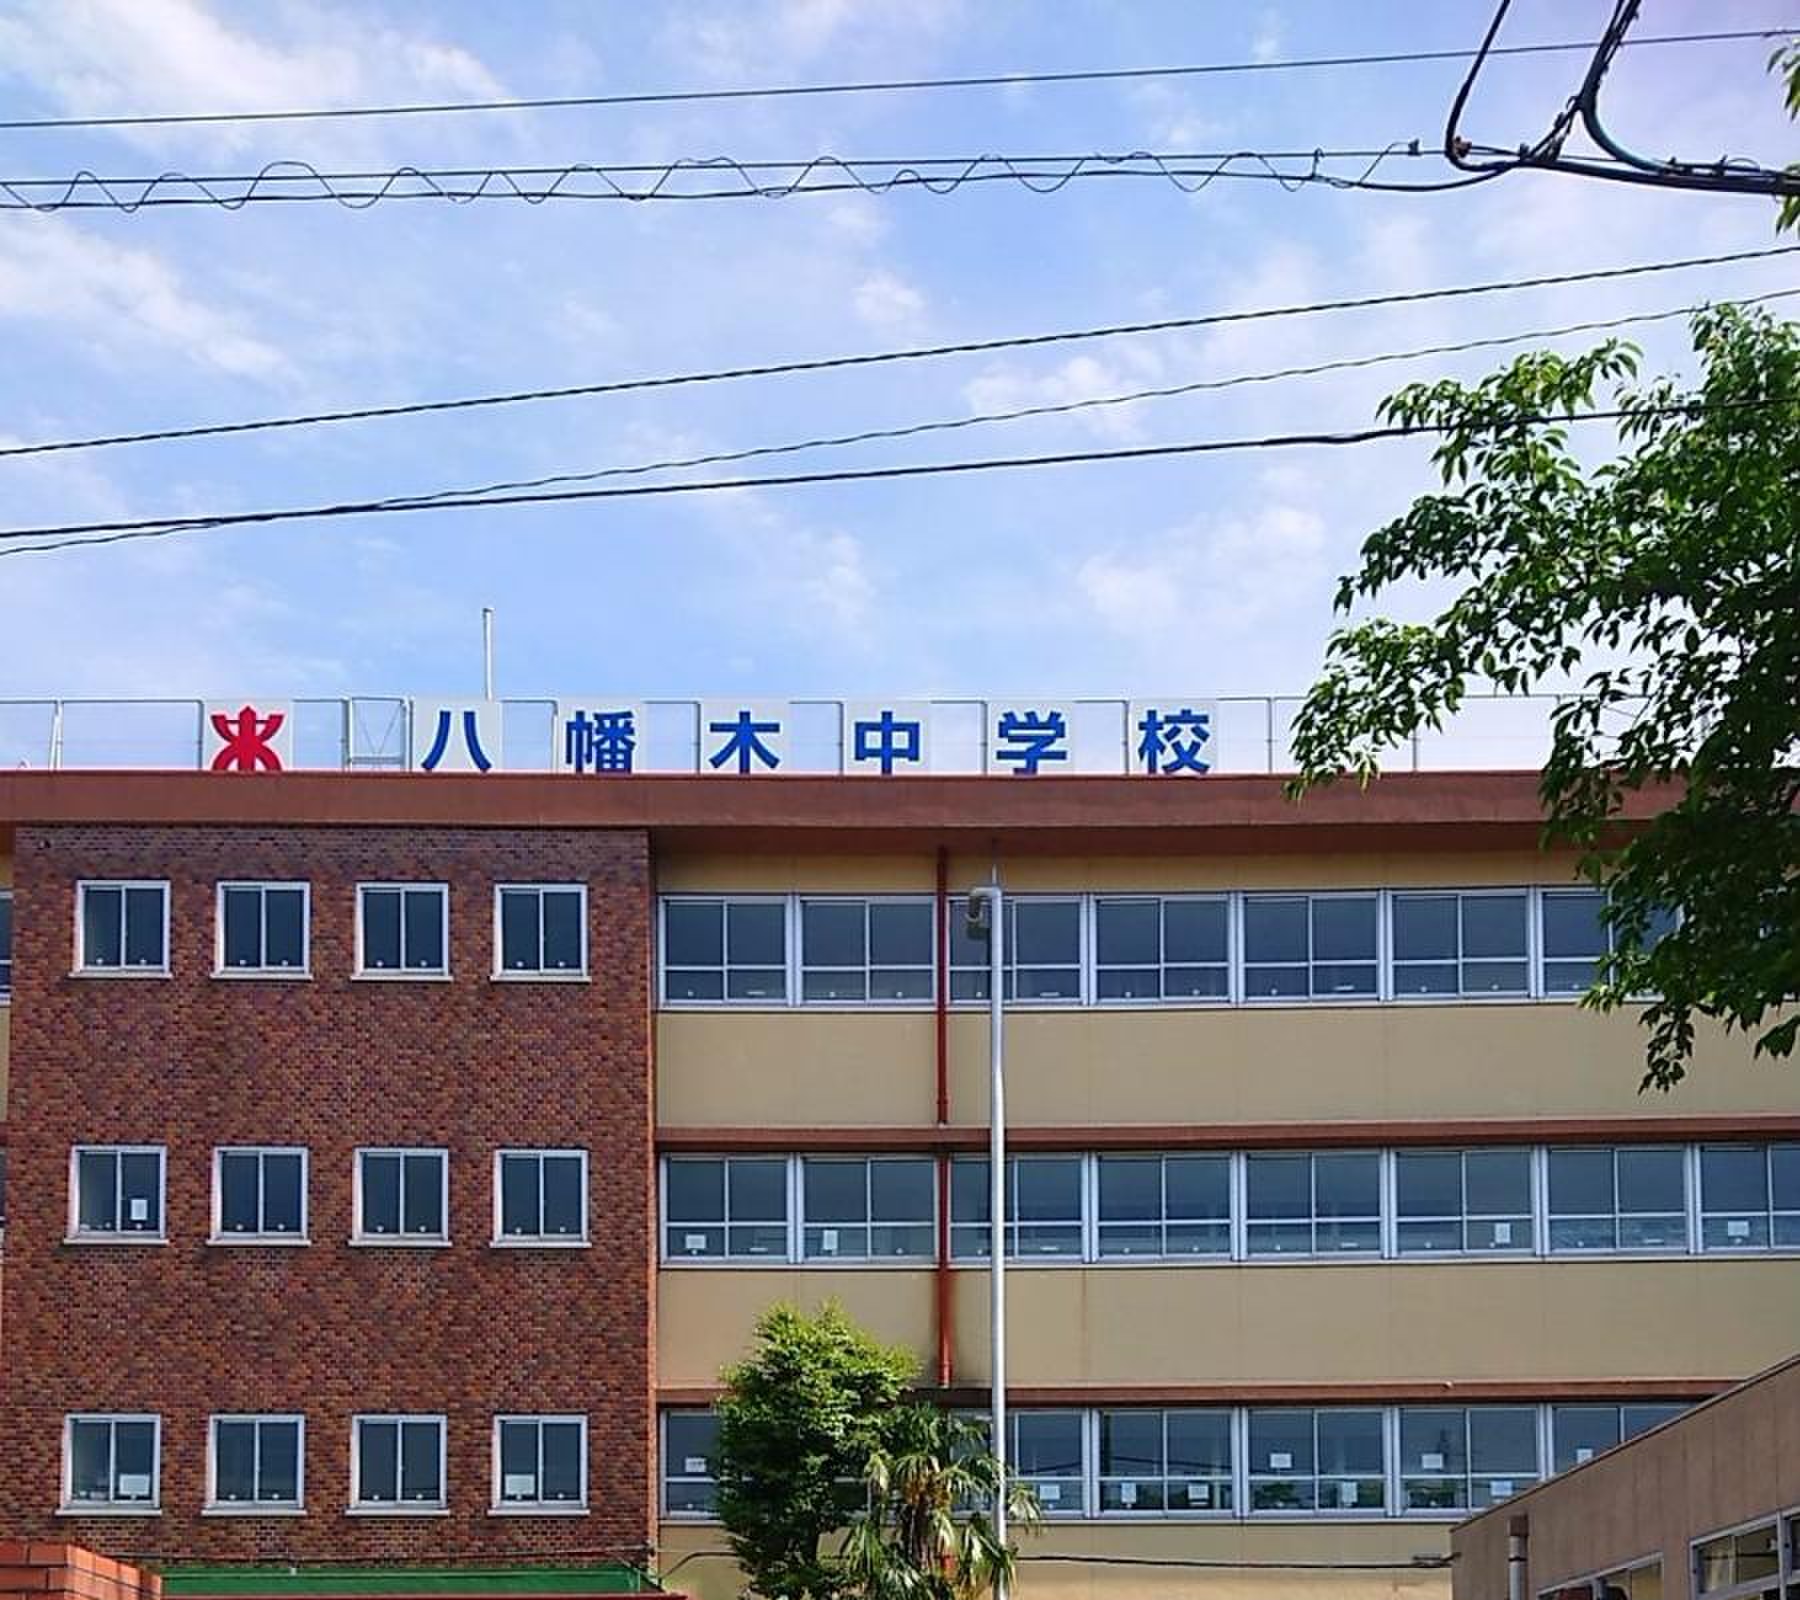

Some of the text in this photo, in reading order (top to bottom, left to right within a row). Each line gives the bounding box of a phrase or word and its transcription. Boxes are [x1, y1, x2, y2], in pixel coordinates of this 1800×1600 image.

[421, 709, 1211, 775] 八幡木中学校
